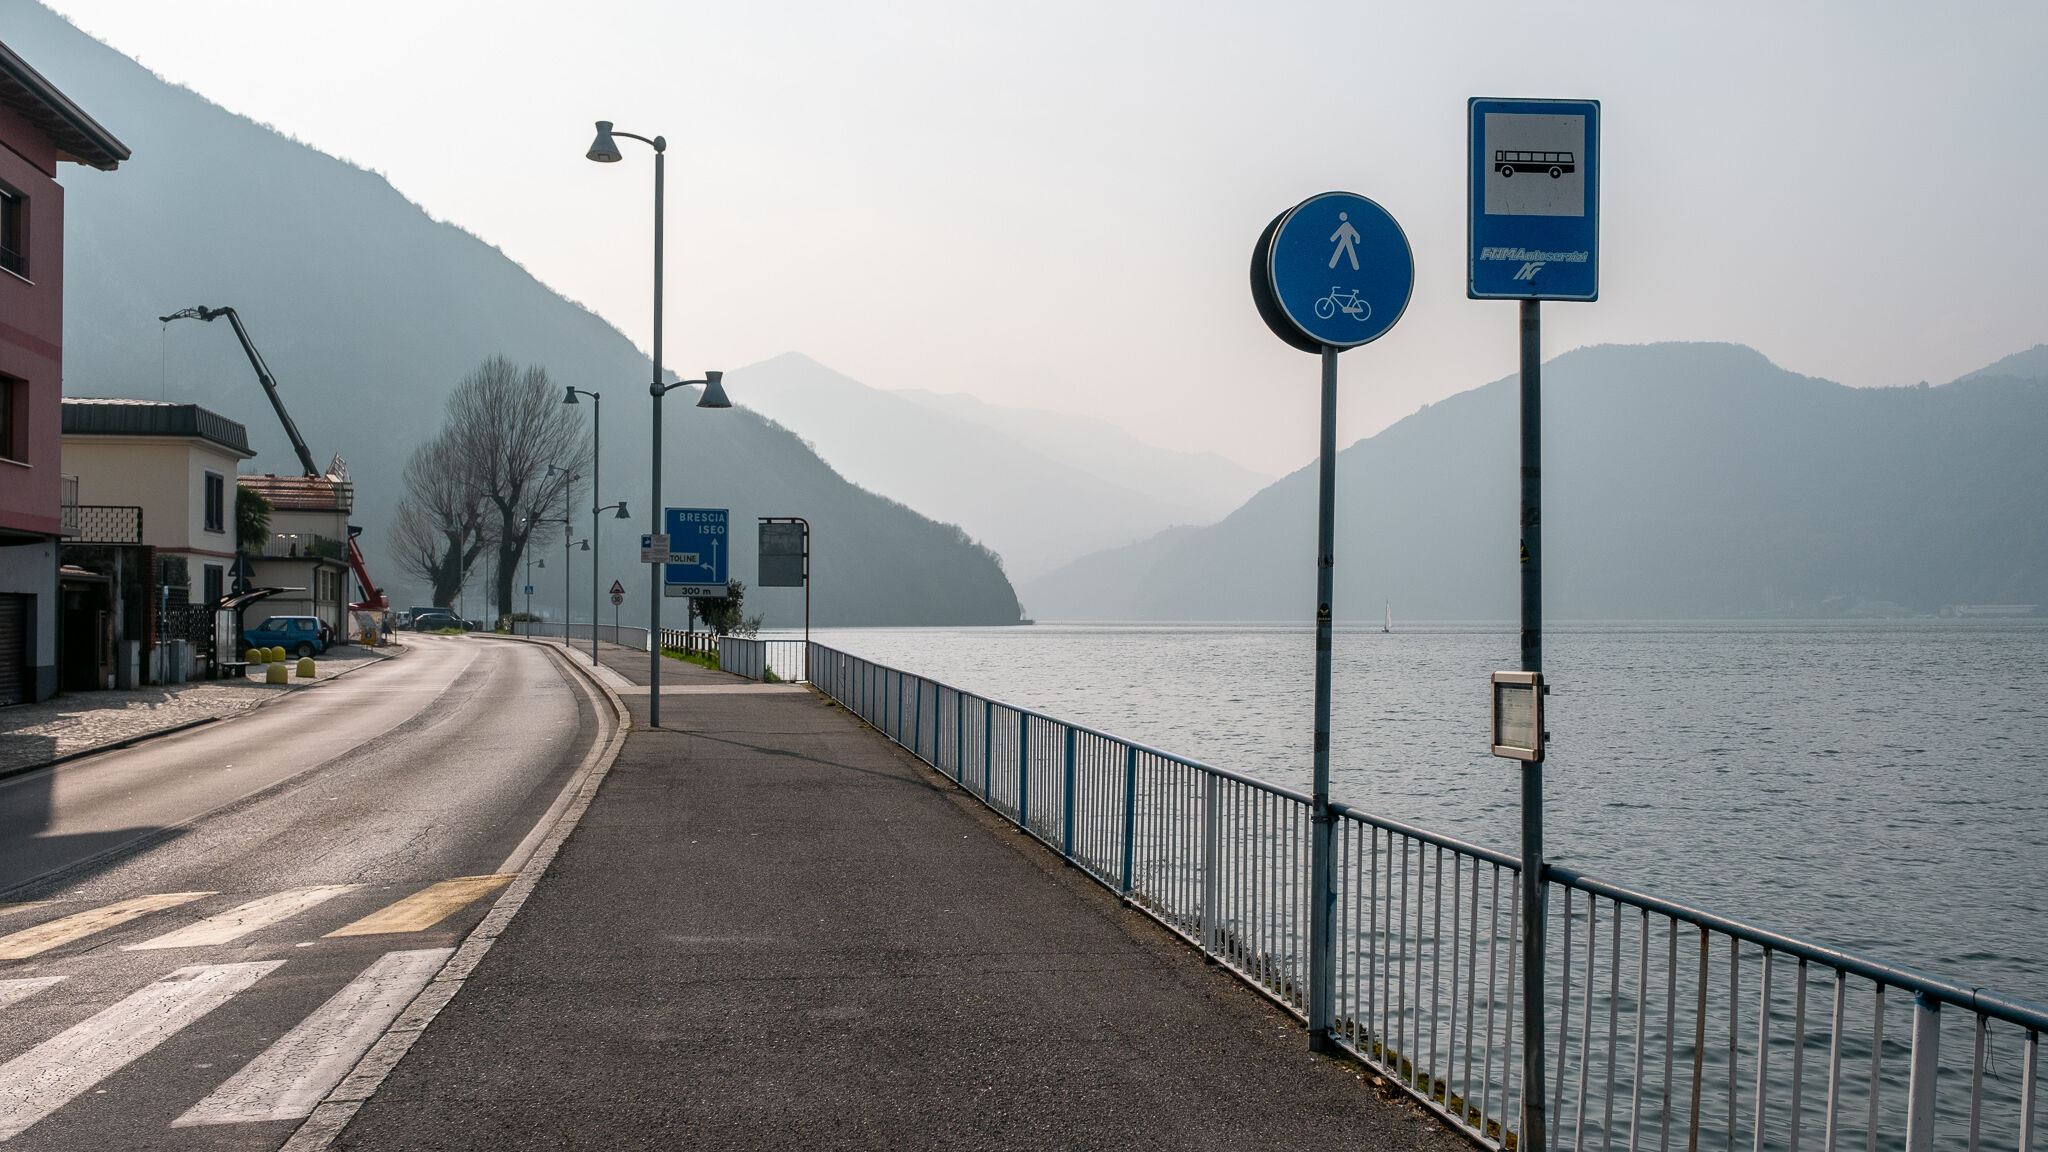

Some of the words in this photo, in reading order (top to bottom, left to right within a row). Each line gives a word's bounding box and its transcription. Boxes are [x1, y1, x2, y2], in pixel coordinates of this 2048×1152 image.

[679, 512, 725, 523] BRESCIA
[698, 525, 725, 535] ISEO
[681, 587, 700, 596] 300
